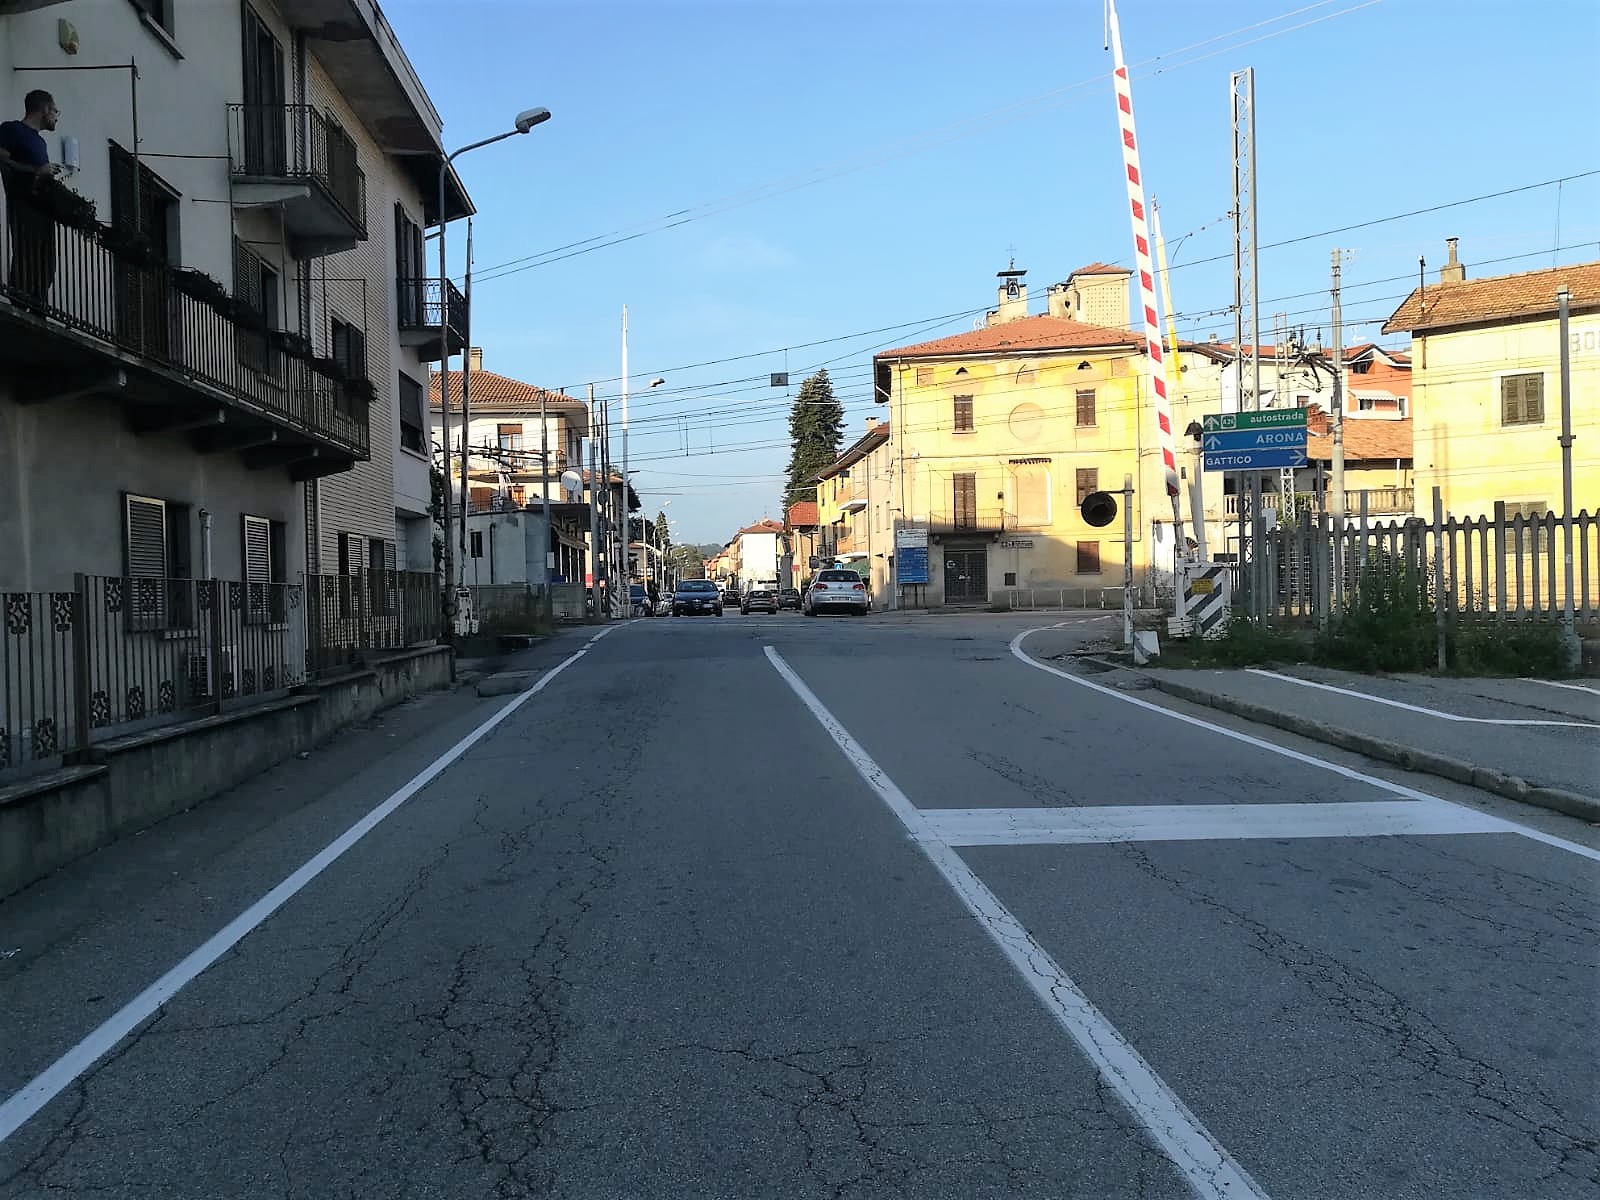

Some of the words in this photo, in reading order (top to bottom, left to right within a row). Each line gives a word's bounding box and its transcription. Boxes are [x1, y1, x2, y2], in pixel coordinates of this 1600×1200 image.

[1570, 330, 1600, 352] BO
[1250, 411, 1304, 423] autostrada
[1256, 432, 1304, 444] ARONA
[1206, 455, 1252, 466] GATTICO
